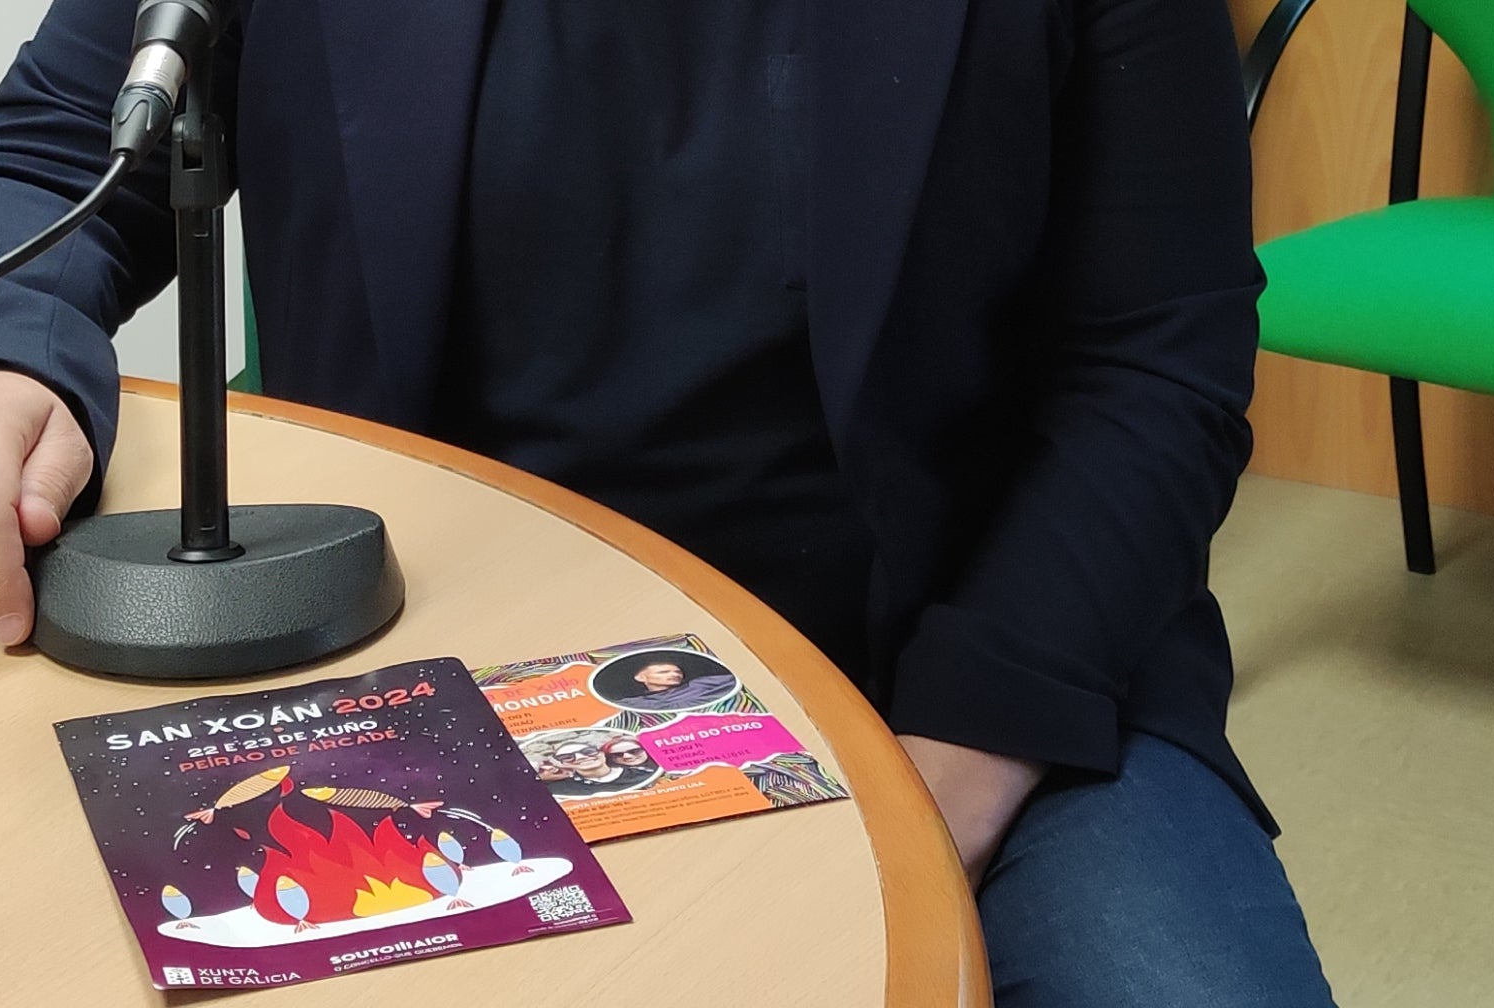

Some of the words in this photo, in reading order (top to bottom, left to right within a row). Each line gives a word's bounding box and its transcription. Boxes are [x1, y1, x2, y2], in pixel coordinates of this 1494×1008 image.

[107, 724, 192, 750] SAN
[203, 703, 323, 734] XOÁN
[332, 682, 435, 714] 2024
[187, 745, 219, 758] 22
[224, 743, 238, 752] E
[242, 737, 273, 749] 23
[277, 732, 307, 744] DE
[312, 721, 378, 739] XUÑO
[270, 746, 299, 758] DE
[308, 730, 398, 752] ARCADE
[654, 734, 695, 748] FLOW
[698, 728, 721, 740] DO
[721, 722, 764, 734] TOXO
[197, 967, 259, 977] XUNTA
[200, 976, 228, 985] DE
[229, 972, 302, 985] GALICIA
